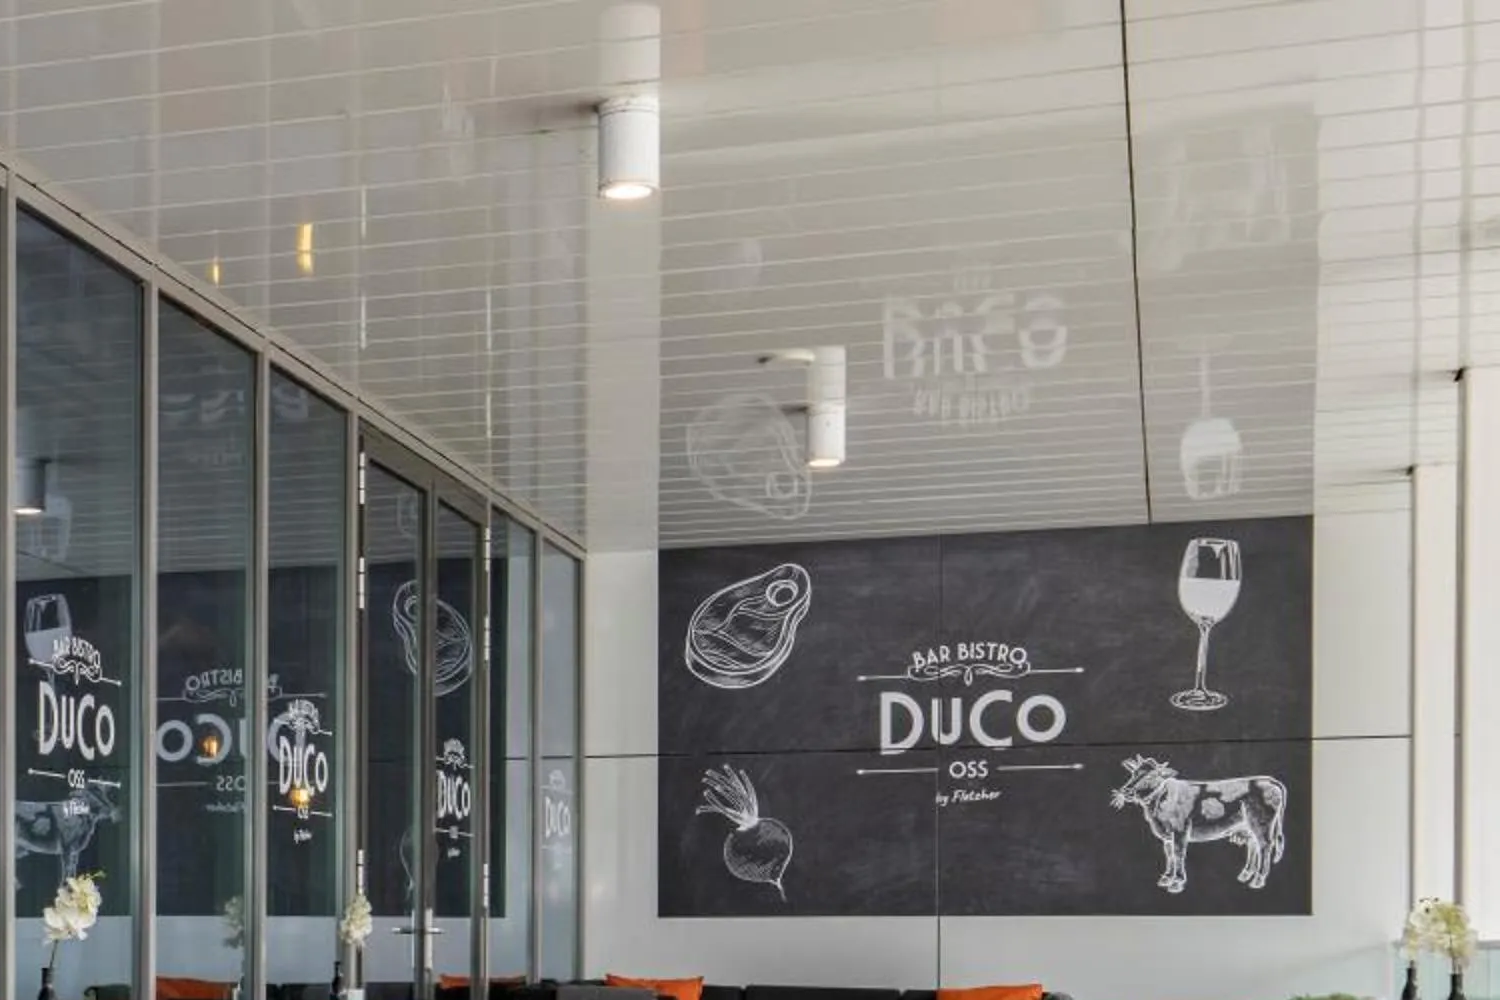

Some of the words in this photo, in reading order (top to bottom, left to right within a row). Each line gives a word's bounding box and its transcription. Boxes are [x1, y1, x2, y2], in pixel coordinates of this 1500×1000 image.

[912, 645, 951, 673] BAR
[957, 642, 1027, 669] BISTRO
[949, 760, 989, 779] OSS
